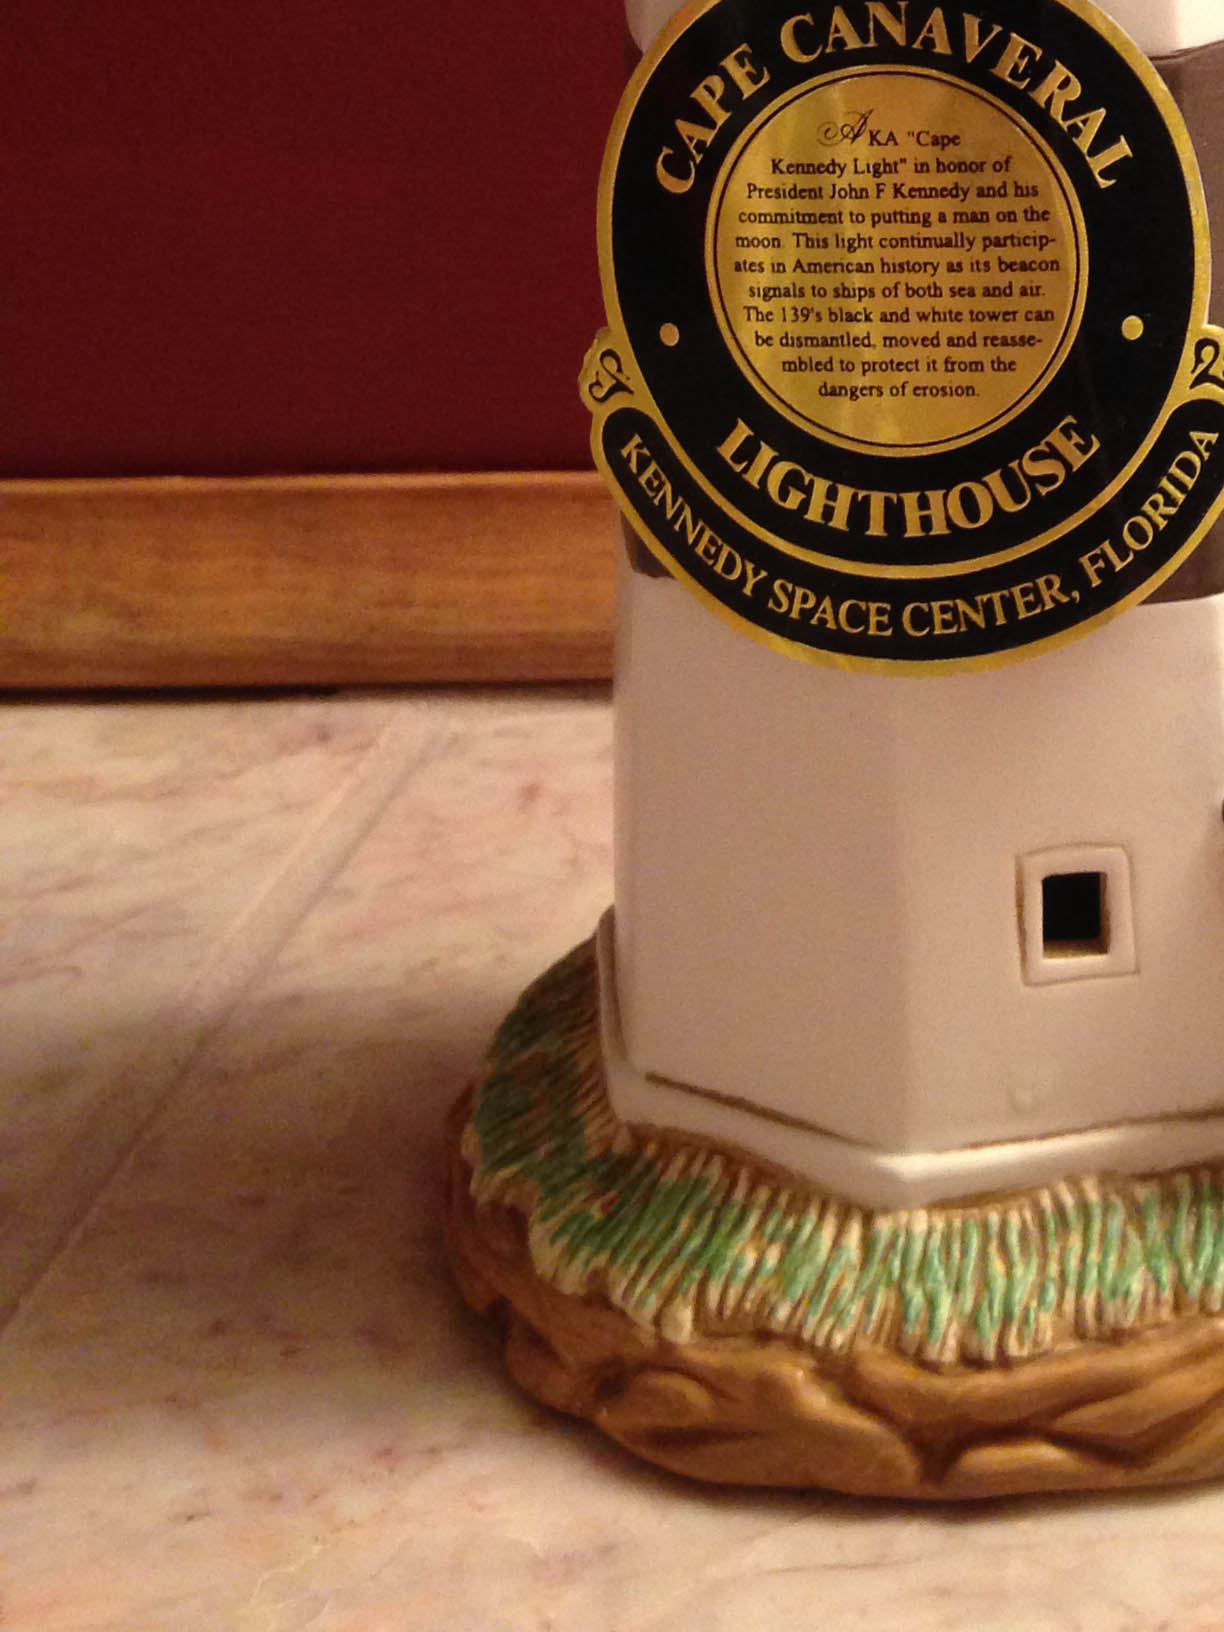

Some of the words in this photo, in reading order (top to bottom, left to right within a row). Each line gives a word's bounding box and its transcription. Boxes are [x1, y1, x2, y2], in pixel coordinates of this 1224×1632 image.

[656, 41, 770, 195] CAPE
[780, 0, 1133, 190] CANAVERAL
[907, 130, 961, 151] "Cape
[771, 158, 847, 178] Kennedy
[853, 157, 907, 178] Light"
[914, 156, 930, 173] in
[936, 157, 986, 173] honor
[992, 155, 1012, 173] of
[747, 183, 823, 199] President
[830, 183, 869, 199] John
[893, 182, 970, 202] Kennedy
[976, 181, 1008, 198] and
[1013, 181, 1039, 198] his
[738, 208, 843, 224] commitment
[849, 210, 865, 224] to
[871, 208, 932, 228] putting
[938, 211, 947, 223] a
[953, 211, 990, 224] man
[996, 211, 1018, 223] on
[1023, 206, 1051, 222] the
[792, 232, 829, 249] This
[835, 233, 873, 253] light
[879, 232, 976, 252] continually
[982, 230, 1056, 252] particip-
[734, 259, 765, 273] ates
[771, 260, 786, 274] in
[792, 258, 874, 274] American
[880, 257, 940, 277] history
[946, 261, 964, 273] as
[970, 258, 991, 273] its
[998, 256, 1060, 272] beacon
[749, 281, 805, 302] signals
[811, 285, 827, 298] to
[833, 282, 876, 302] ships
[882, 282, 901, 298] of
[905, 282, 943, 298] both
[949, 285, 976, 298] sea
[982, 281, 1013, 298] and
[1019, 281, 1046, 297] air.
[743, 306, 774, 322] The
[781, 307, 822, 323] 139's
[828, 307, 873, 323] black
[880, 307, 910, 323] and
[916, 306, 964, 323] white
[969, 309, 1019, 322] tower
[1024, 309, 1055, 322] can
[755, 331, 774, 347] be
[882, 331, 941, 348] moved
[946, 331, 977, 348] and
[983, 334, 1043, 348] reasse-
[782, 356, 834, 372] mbled
[839, 360, 856, 372] to
[861, 359, 920, 377] protect
[926, 356, 937, 372] it
[944, 356, 985, 373] from
[990, 356, 1017, 372] the
[818, 381, 883, 401] dangers
[889, 381, 909, 397] of
[912, 380, 980, 397] erosion.
[714, 414, 1100, 538] LIGHTHOUSE
[620, 431, 768, 596] KENNEDY
[769, 576, 894, 636] SPACE
[902, 572, 1080, 637] CENTER,
[1087, 424, 1219, 590] FLORIDA
